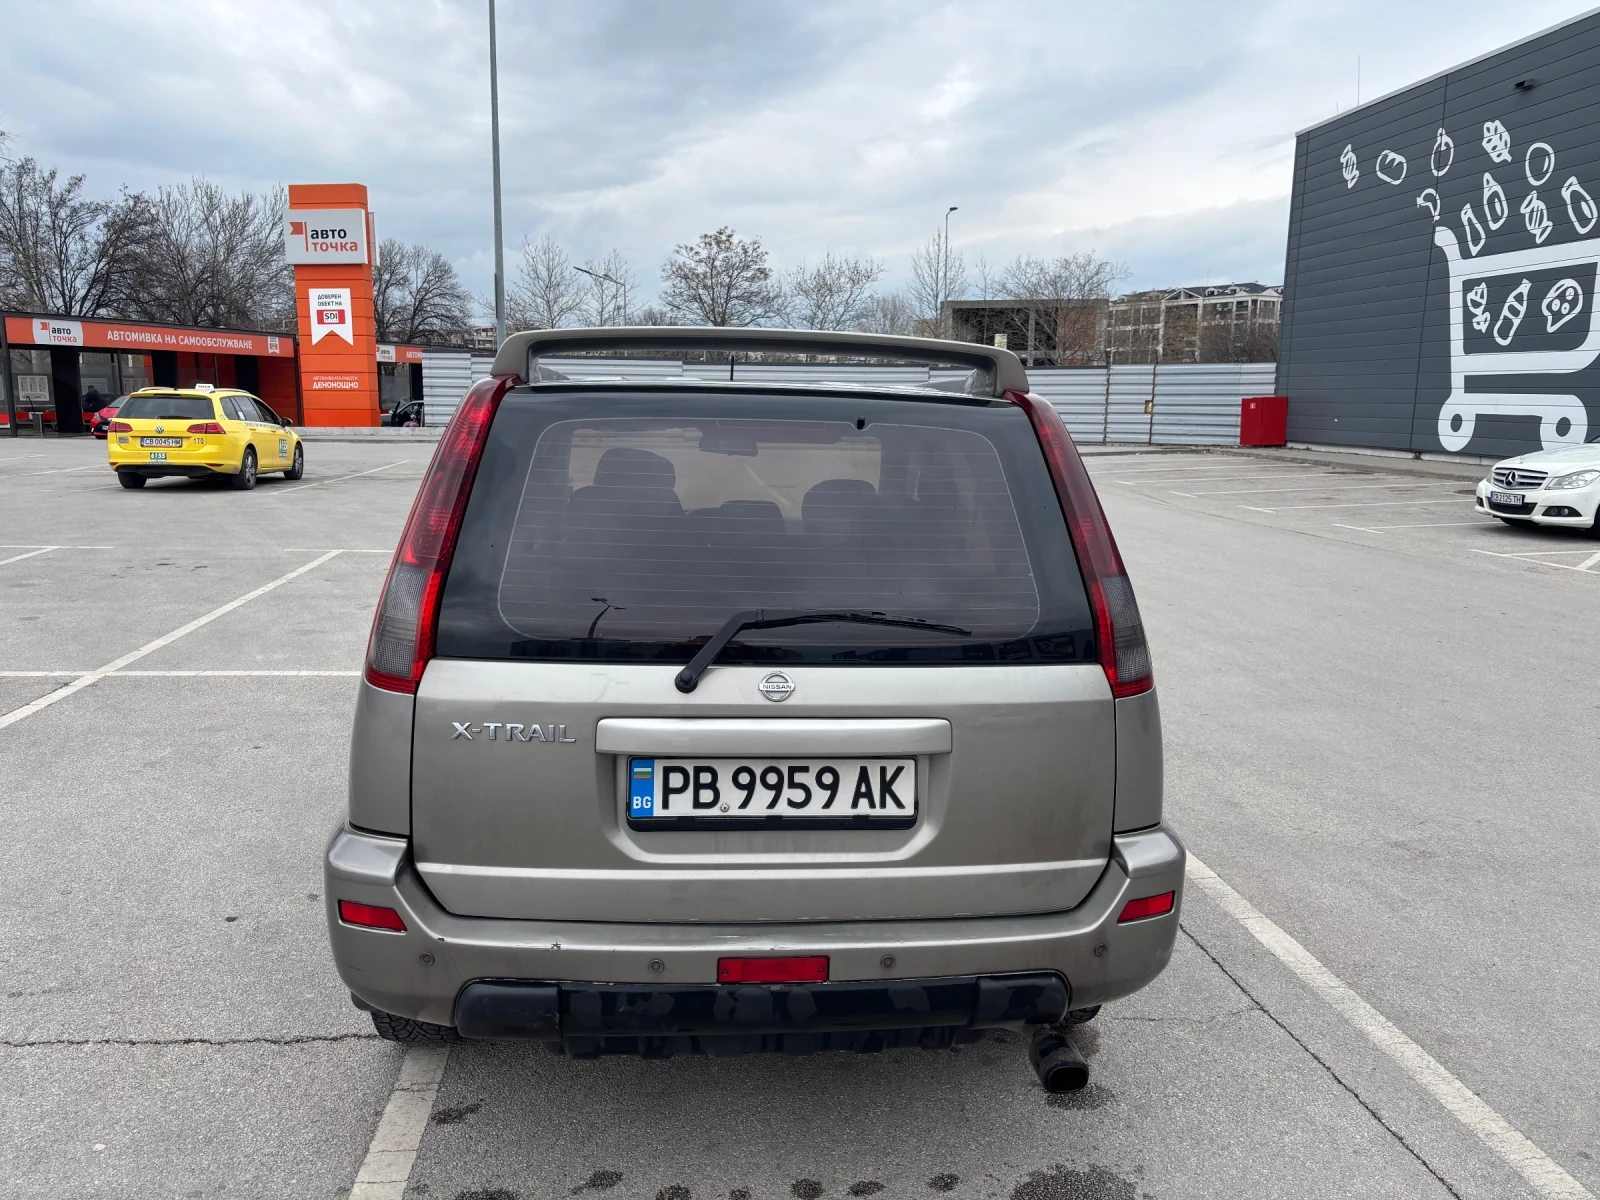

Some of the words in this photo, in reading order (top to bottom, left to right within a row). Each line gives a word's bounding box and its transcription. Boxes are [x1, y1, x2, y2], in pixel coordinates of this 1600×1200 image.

[310, 228, 347, 239] авто
[311, 241, 358, 251] точка
[324, 312, 338, 320] SDI
[51, 327, 72, 336] авто
[52, 335, 78, 343] точка
[106, 330, 163, 344] АВТОМИВКА
[164, 335, 177, 345] НА
[178, 336, 253, 349] САМООБСЛУЖВАНЕ
[312, 381, 359, 390] ДЕНОНОЩНО
[450, 721, 577, 744] X-TRAIL
[661, 765, 721, 811] PB
[731, 765, 841, 811] 9959
[850, 765, 906, 811] AK
[632, 796, 652, 810] BG
